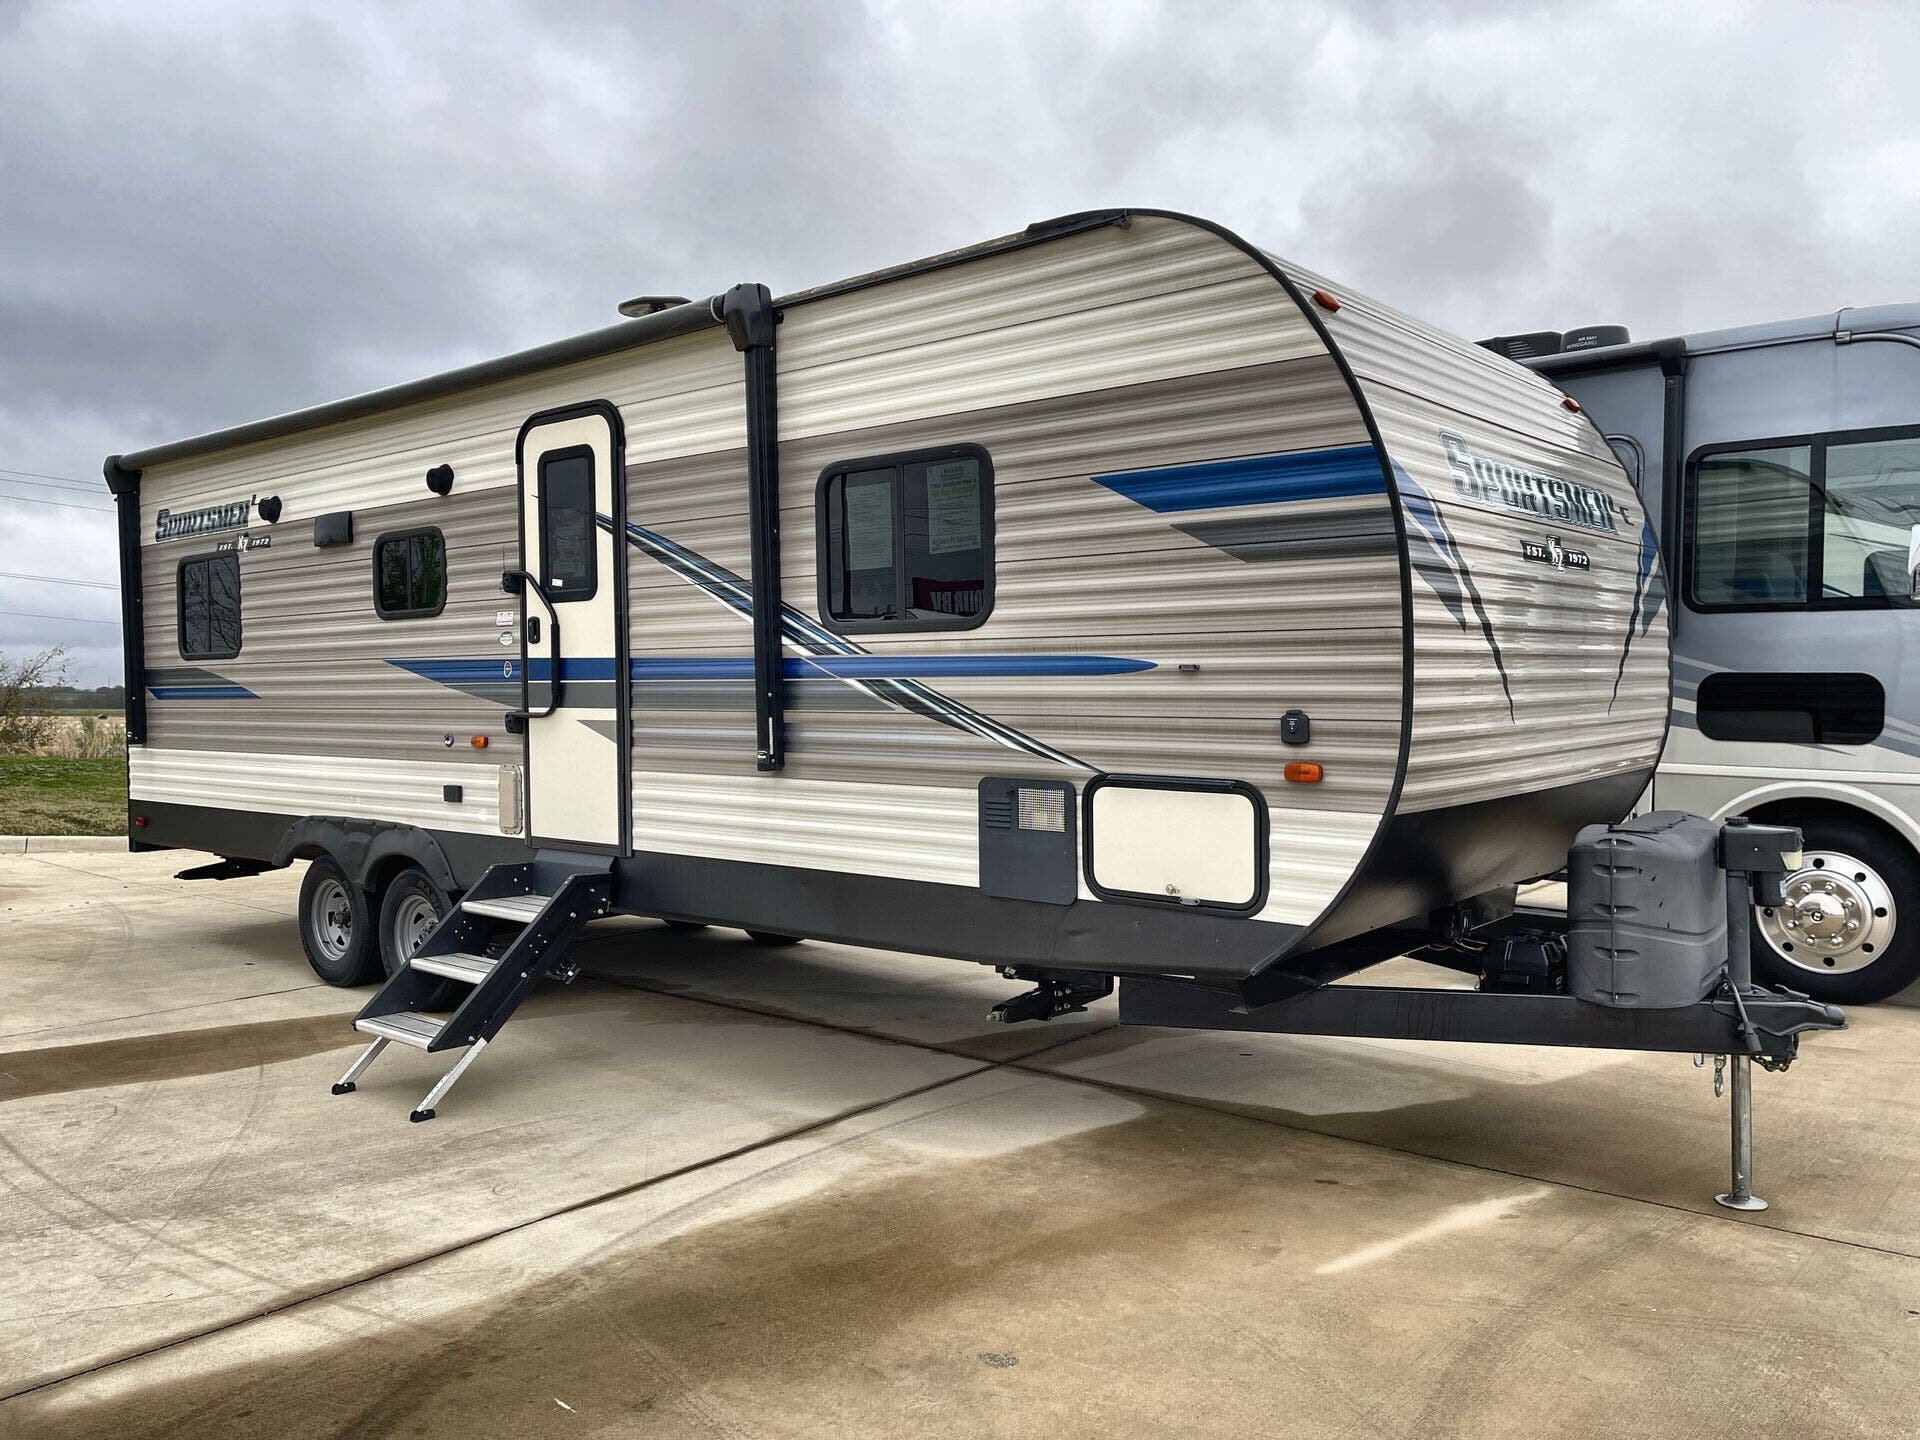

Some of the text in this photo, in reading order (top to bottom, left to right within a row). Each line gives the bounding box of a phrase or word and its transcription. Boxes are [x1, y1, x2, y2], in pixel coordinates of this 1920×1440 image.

[1440, 428, 1618, 535] SPORTSMEN
[155, 499, 251, 542] SPORTSMEN
[252, 538, 270, 546] 1972
[1526, 545, 1546, 558] EST.
[1568, 552, 1589, 565] 1972
